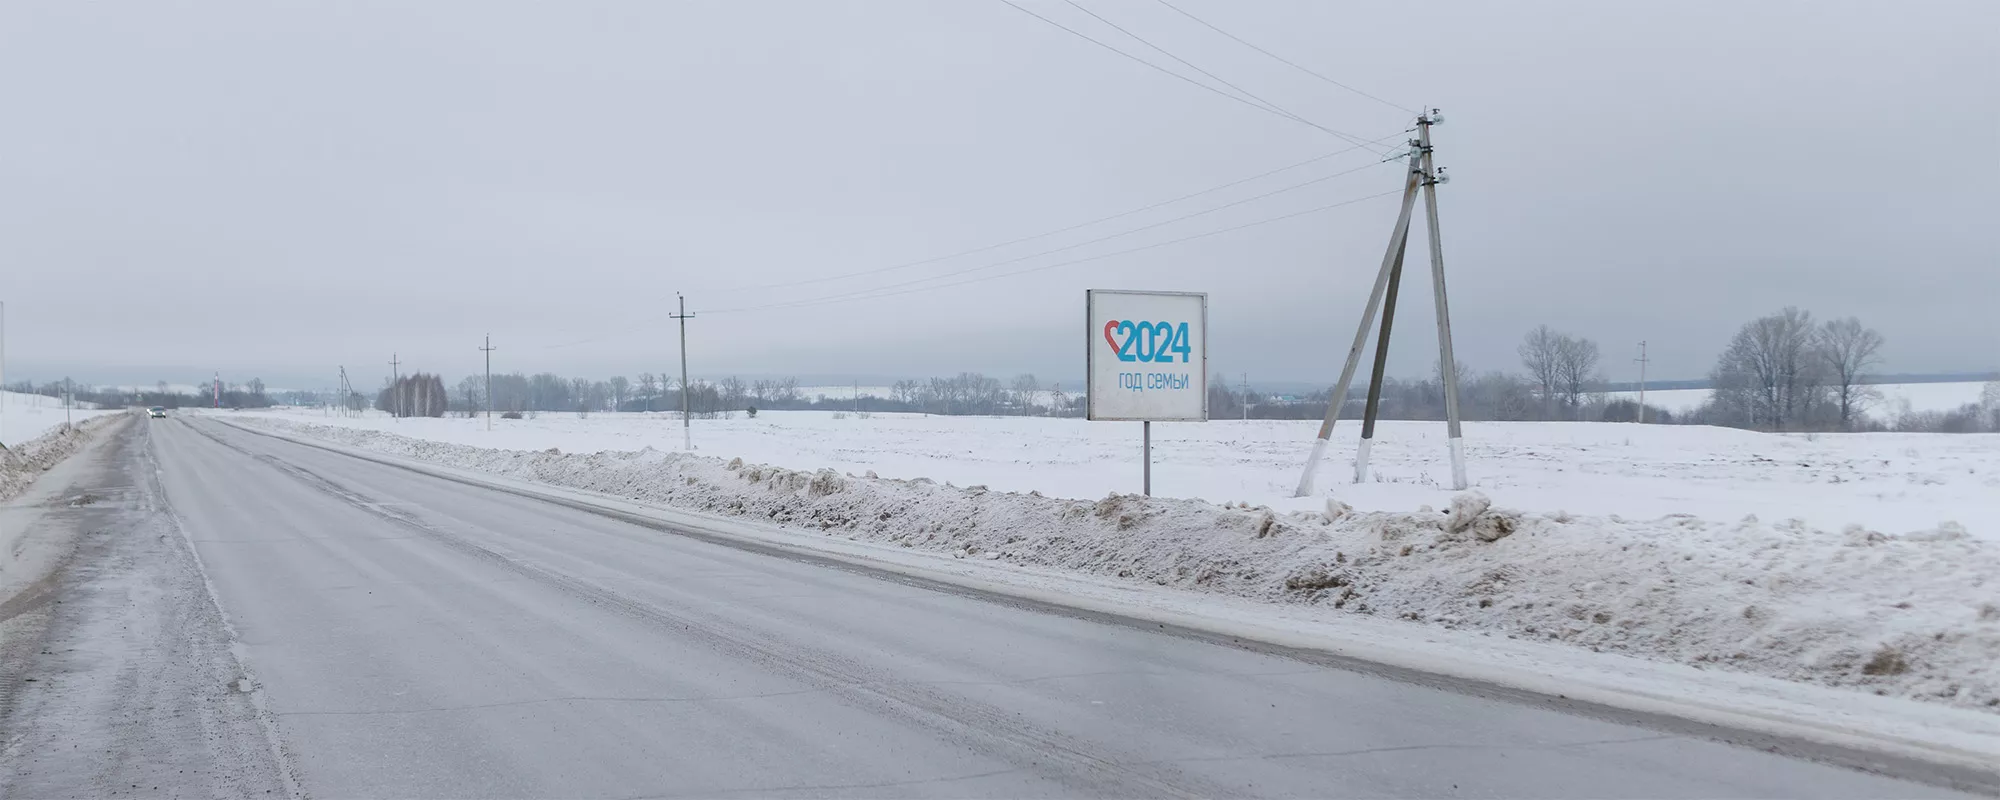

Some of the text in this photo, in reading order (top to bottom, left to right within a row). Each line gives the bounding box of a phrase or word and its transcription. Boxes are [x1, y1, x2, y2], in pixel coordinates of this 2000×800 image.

[1117, 320, 1191, 363] 2024
[1119, 372, 1189, 392] год семьи
